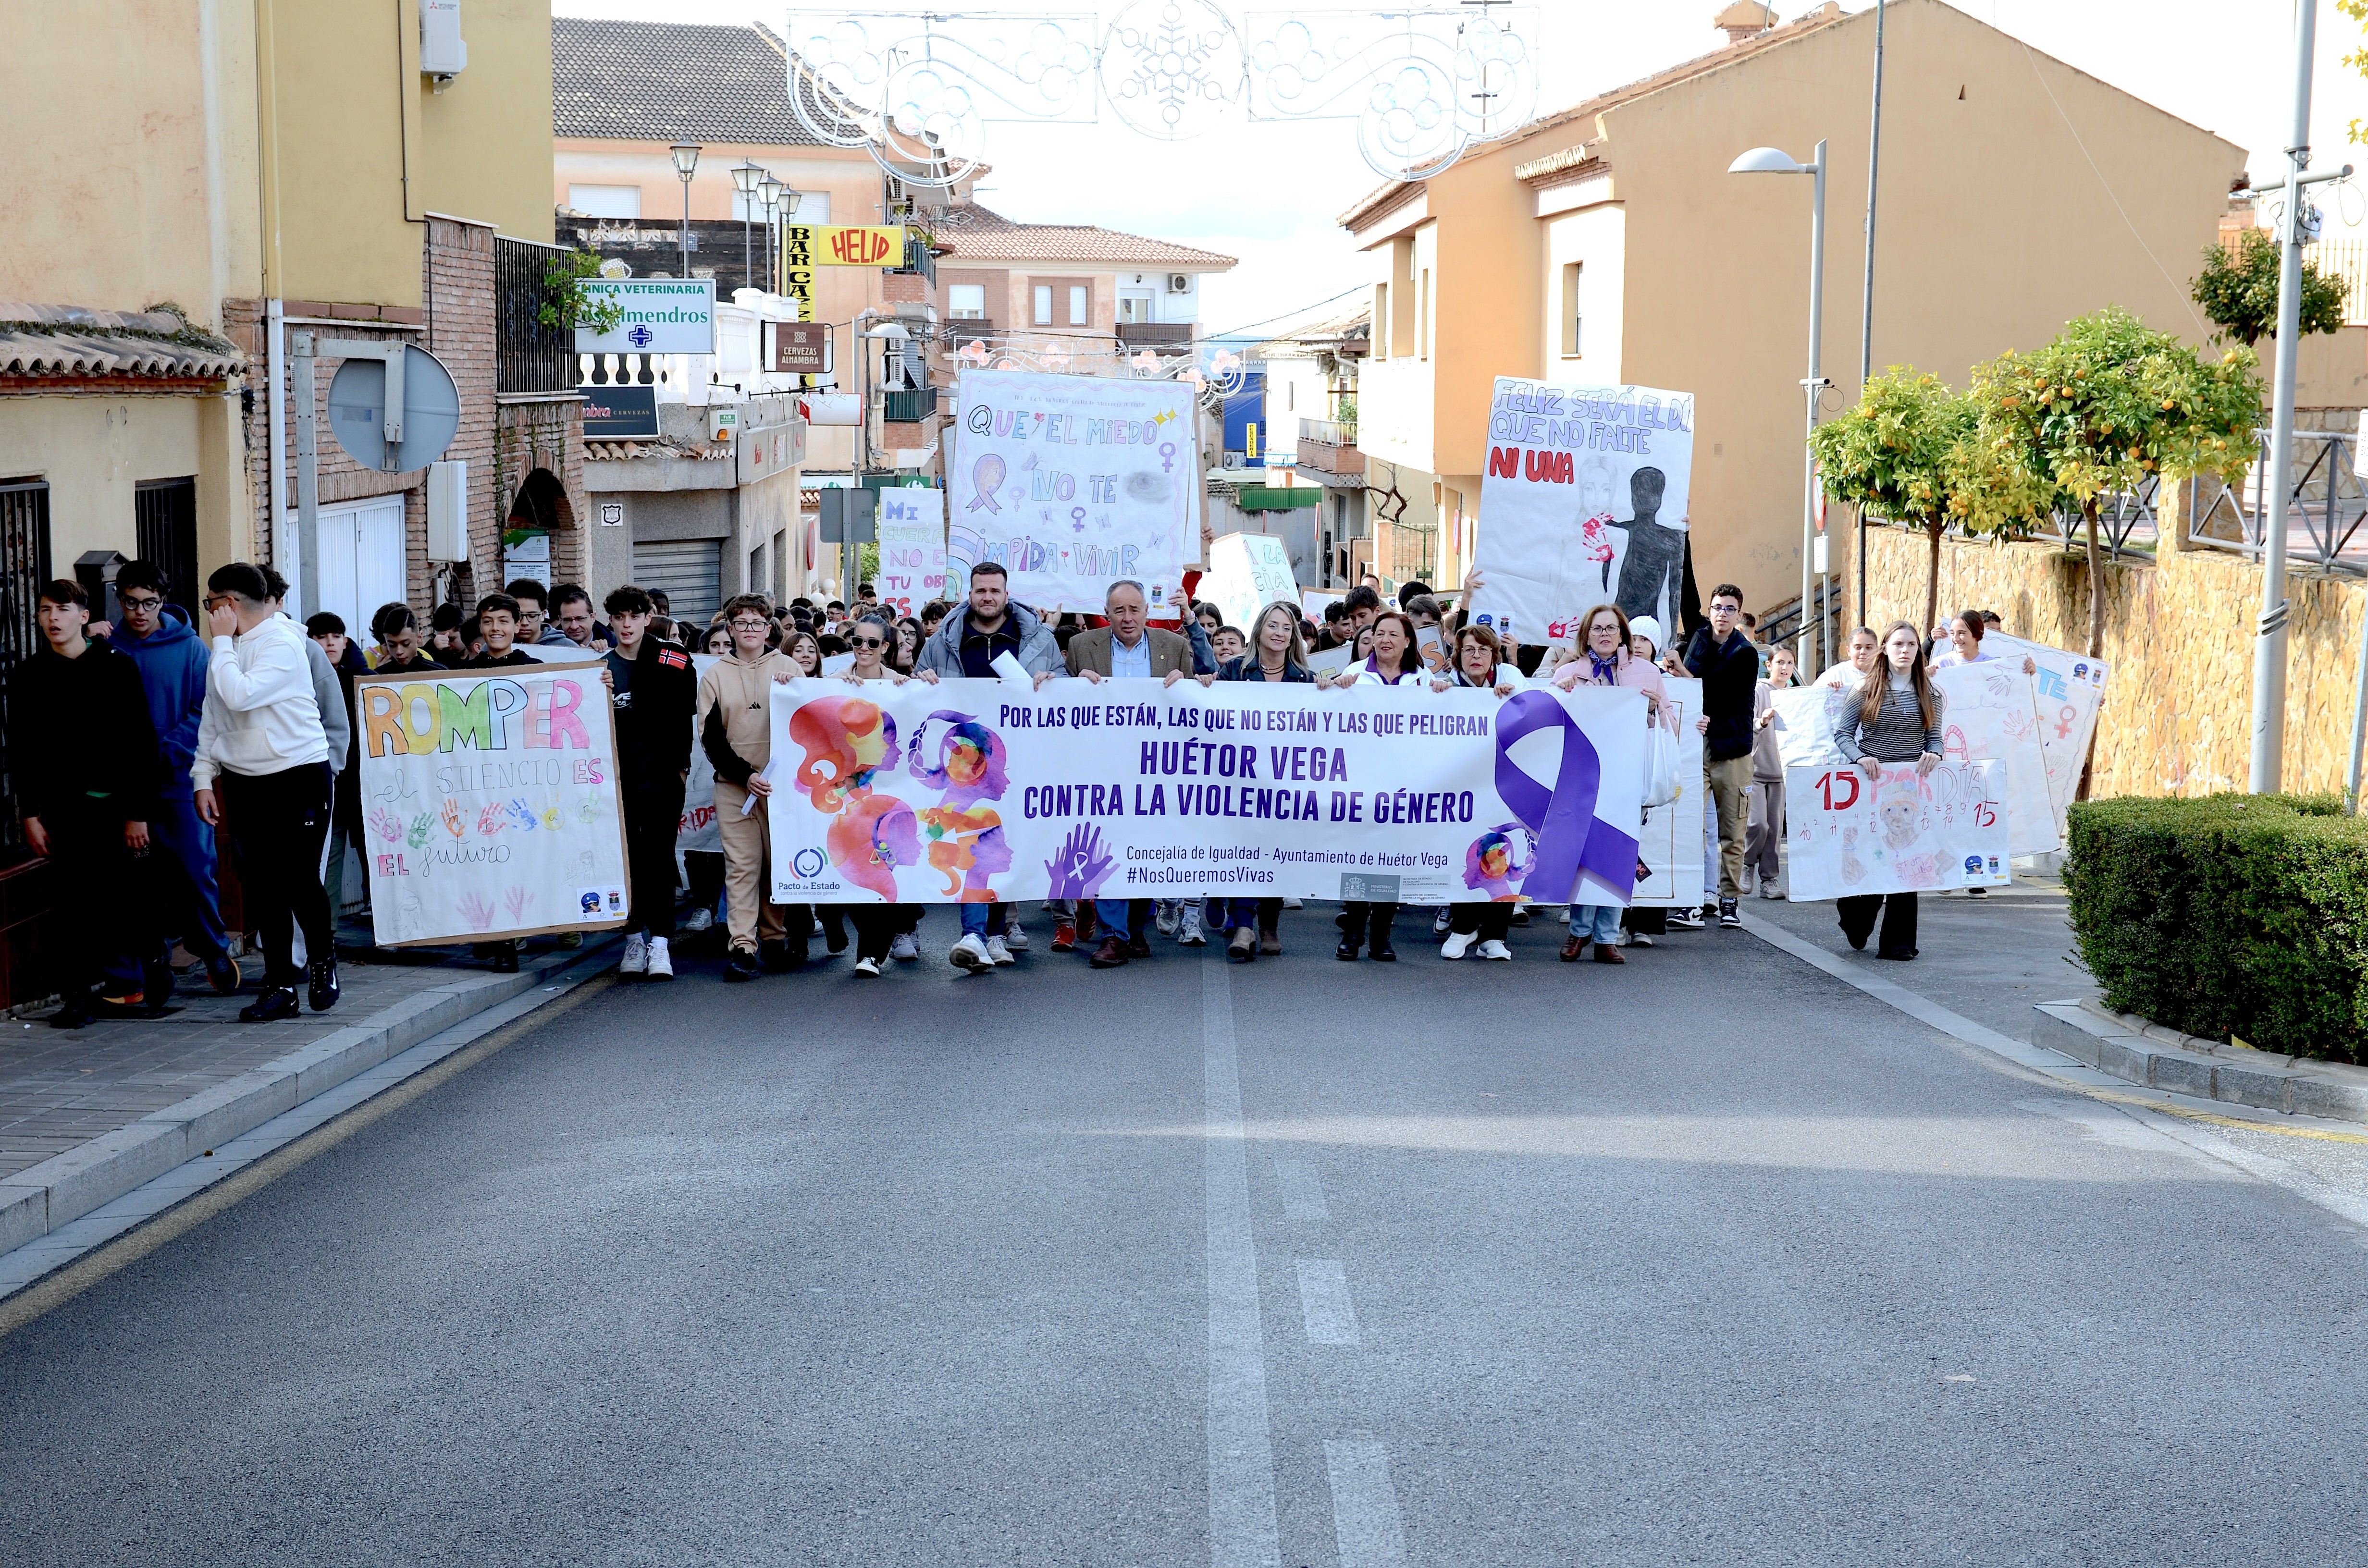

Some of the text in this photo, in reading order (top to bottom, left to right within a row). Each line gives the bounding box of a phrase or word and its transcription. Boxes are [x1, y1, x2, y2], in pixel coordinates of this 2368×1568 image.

[789, 228, 810, 266] BAR
[624, 284, 705, 294] VETERINARIA
[611, 306, 708, 323] lmendros
[781, 356, 819, 365] ALHAMBRA
[1494, 380, 1564, 416] FELIZ
[1571, 386, 1635, 425] SERÁ
[1639, 395, 1666, 429] EL
[968, 404, 1030, 439] QUE
[1046, 414, 1077, 445] EL
[1491, 410, 1652, 454] QUE NO FALTE
[1490, 446, 1574, 484] NI UNA
[1031, 469, 1118, 503] NO TE
[886, 501, 918, 520] MI
[890, 549, 923, 567] NO
[1263, 544, 1286, 565] LA
[886, 576, 911, 590] TU
[361, 678, 590, 759] ROMPER
[1038, 707, 1066, 727] LAS
[1071, 706, 1100, 730] QUE
[1106, 702, 1162, 730] ESTÁN,
[1168, 707, 1198, 728] LAS
[1204, 709, 1234, 732] QUE
[1241, 710, 1261, 731] NO
[1267, 708, 1317, 732] ESTÁN
[1323, 712, 1332, 732] Y
[1338, 713, 1368, 733] LAS
[1373, 714, 1404, 737] QUE
[1409, 714, 1488, 736] PELIGRAN
[1140, 737, 1347, 782] HUÉTOR VEGA
[436, 758, 561, 794] SILENCIO
[573, 758, 604, 784] ES
[1814, 771, 1860, 811] 15
[1937, 762, 1988, 806] DÍA
[1024, 784, 1473, 824] CONTRA LA VIOLENCIA DE GÉNERO
[1831, 816, 1837, 824] 3
[1924, 806, 1928, 816] 6
[1946, 804, 1953, 815] 8
[1960, 804, 1966, 815] 9
[1973, 801, 1998, 828] 15
[1799, 816, 1953, 841] 10 11 12 13 14
[377, 835, 510, 878] EL futuro
[1127, 845, 1187, 863] Concejalía
[1192, 845, 1205, 859] de
[1209, 845, 1260, 862] Igualdad
[1273, 847, 1356, 864] Ayuntamiento
[1360, 851, 1374, 865] de
[1378, 852, 1418, 866] Huétor
[1421, 852, 1448, 869] Vega
[811, 882, 840, 890] Estado
[1127, 867, 1273, 883] #NosQueremosVivas
